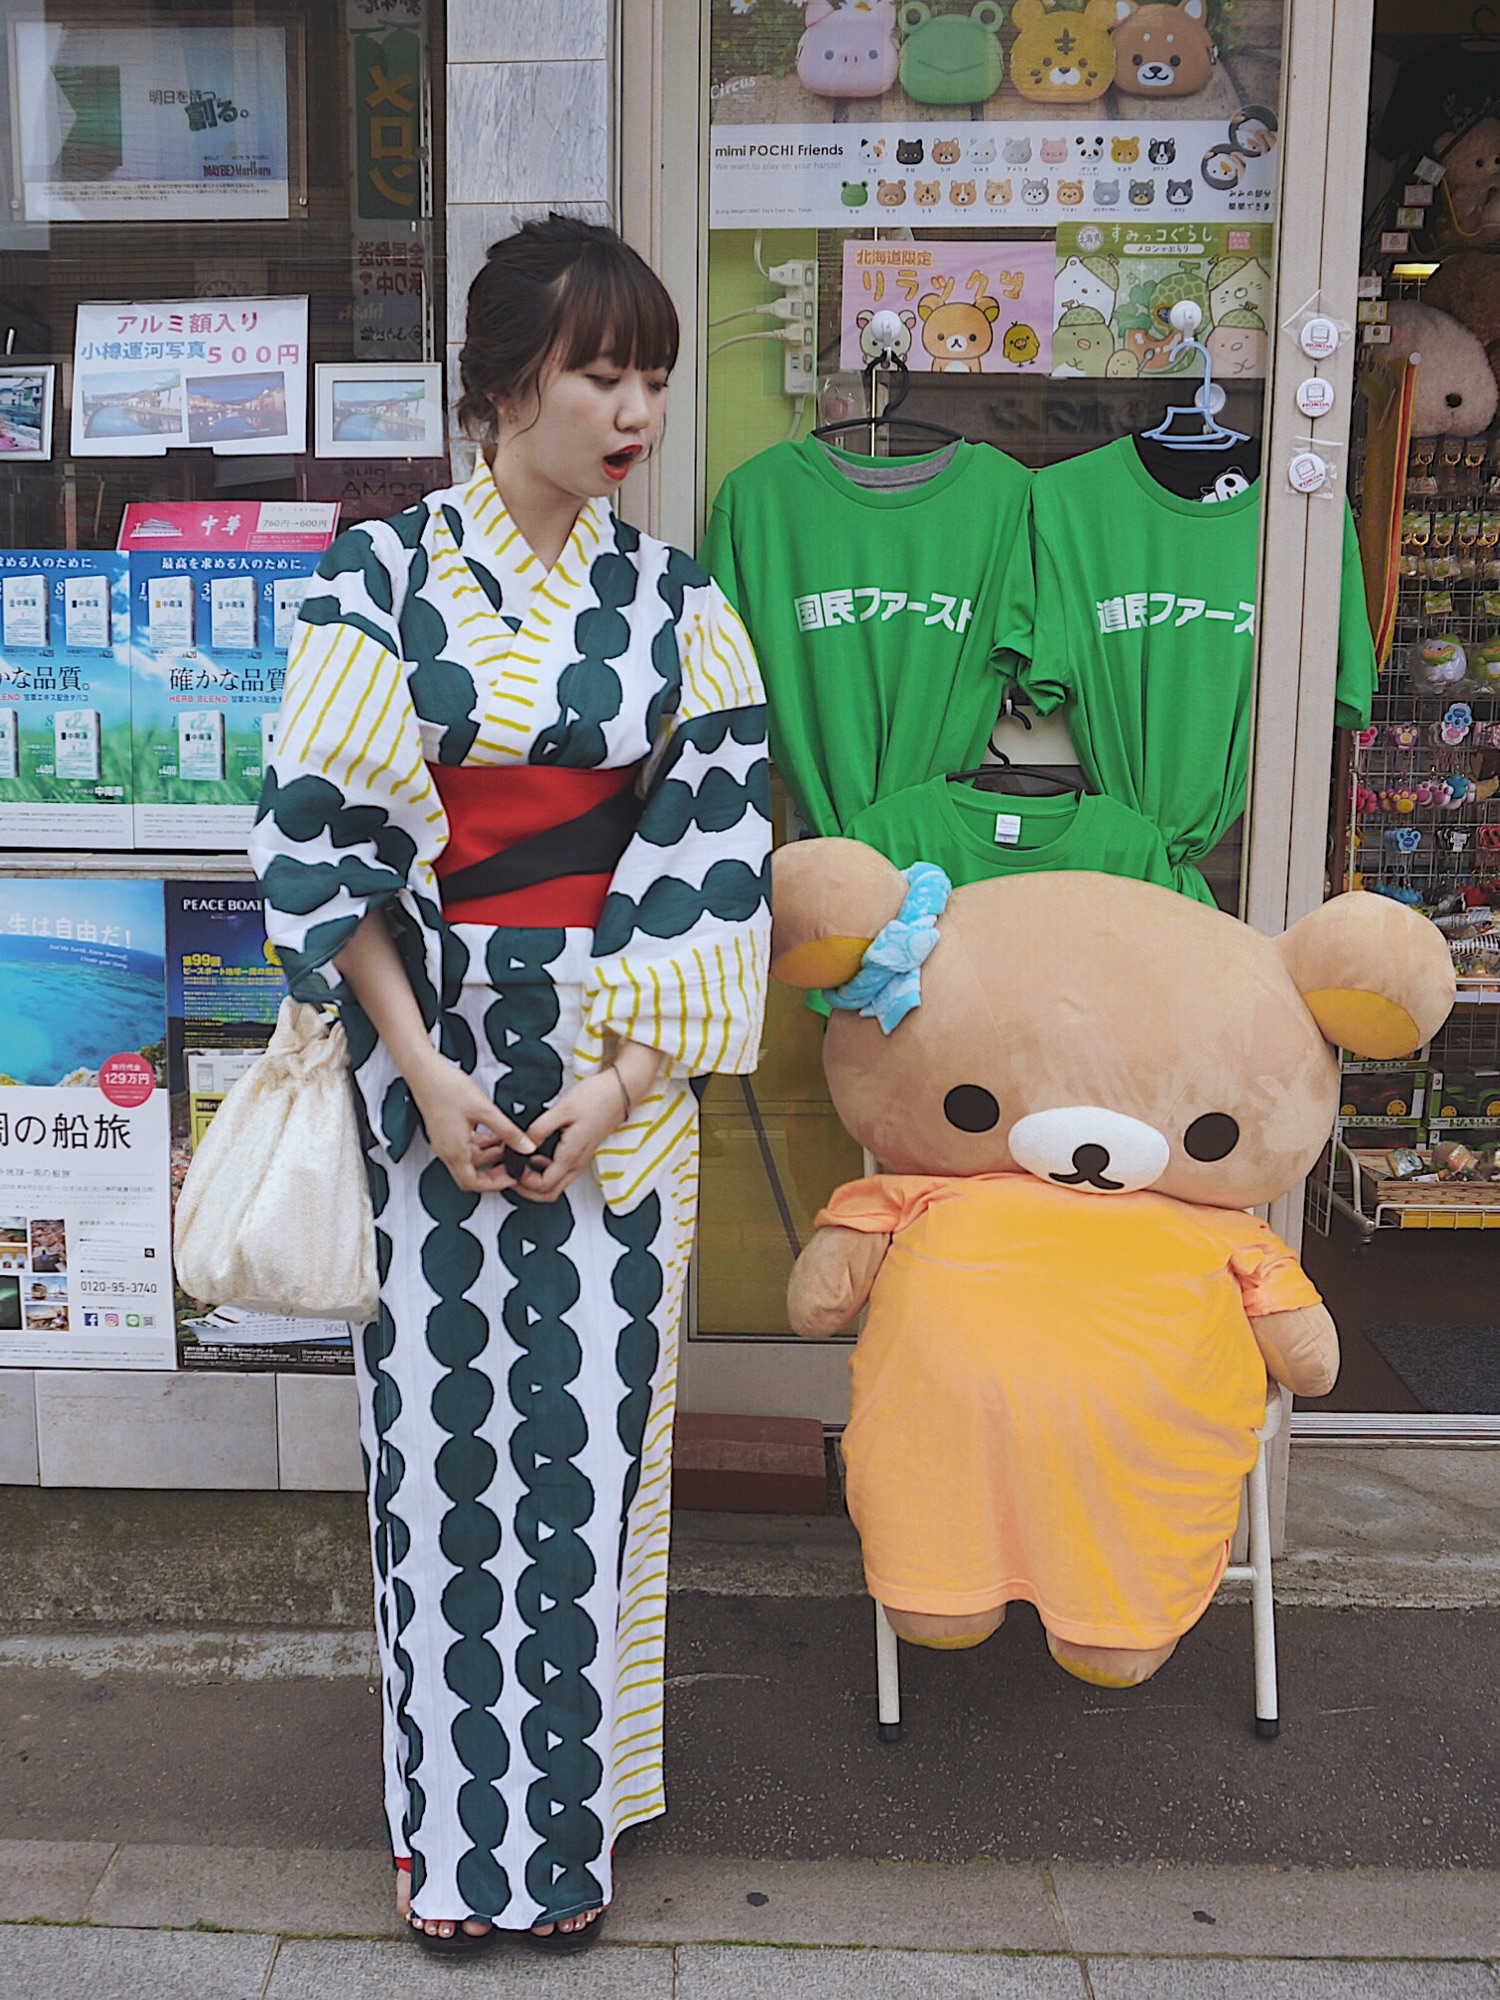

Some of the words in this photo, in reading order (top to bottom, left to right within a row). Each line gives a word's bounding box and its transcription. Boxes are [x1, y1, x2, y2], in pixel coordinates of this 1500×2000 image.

[710, 77, 756, 99] Circus
[715, 145, 746, 157] mimi
[749, 145, 794, 157] POCHI
[797, 144, 844, 156] Friends
[752, 162, 761, 170] to
[762, 162, 780, 171] play
[1111, 223, 1213, 244] すみっコぐらし
[855, 249, 933, 266] 北海道限定
[116, 311, 258, 335] アルミ額入り
[81, 340, 206, 361] 小樽運河写真
[163, 556, 307, 571] 最高を求める人のために。
[794, 587, 975, 634] 国民ファースト
[169, 667, 287, 693] 確かな品質
[0, 693, 20, 701] END
[169, 694, 194, 703] HERB
[197, 694, 228, 703] BLEND
[183, 899, 227, 911] PEACE
[0, 912, 132, 949] 生は自由だ!
[104, 1072, 150, 1086] 129万円
[0, 1112, 132, 1150] の船旅
[80, 1280, 157, 1294] 0120-95-3740
